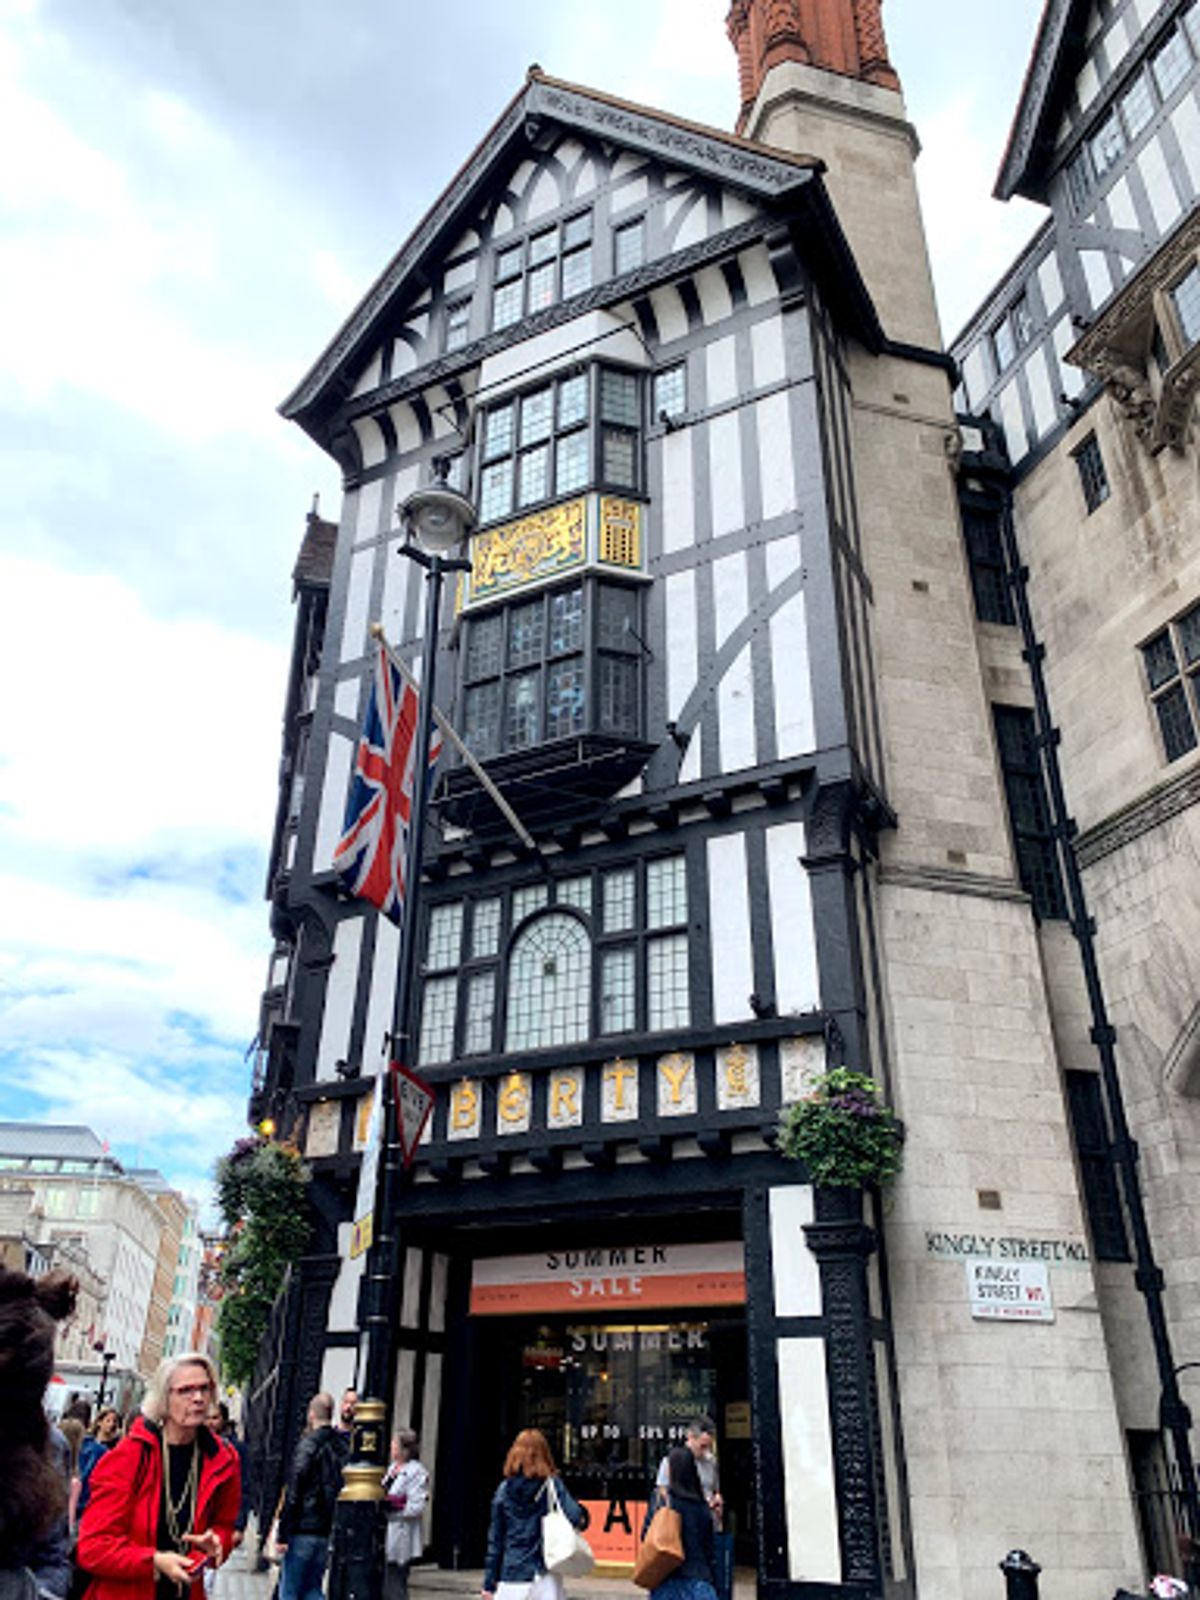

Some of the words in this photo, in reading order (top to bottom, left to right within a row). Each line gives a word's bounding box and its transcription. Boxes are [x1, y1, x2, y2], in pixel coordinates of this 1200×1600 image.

[357, 1061, 693, 1143] BERTY
[546, 1246, 667, 1270] SUMMER
[925, 1231, 995, 1257] KINGLY
[997, 1236, 1061, 1261] STREET
[569, 1275, 643, 1297] SALE
[976, 1283, 1021, 1301] STREET
[570, 1328, 705, 1352] SUMMER
